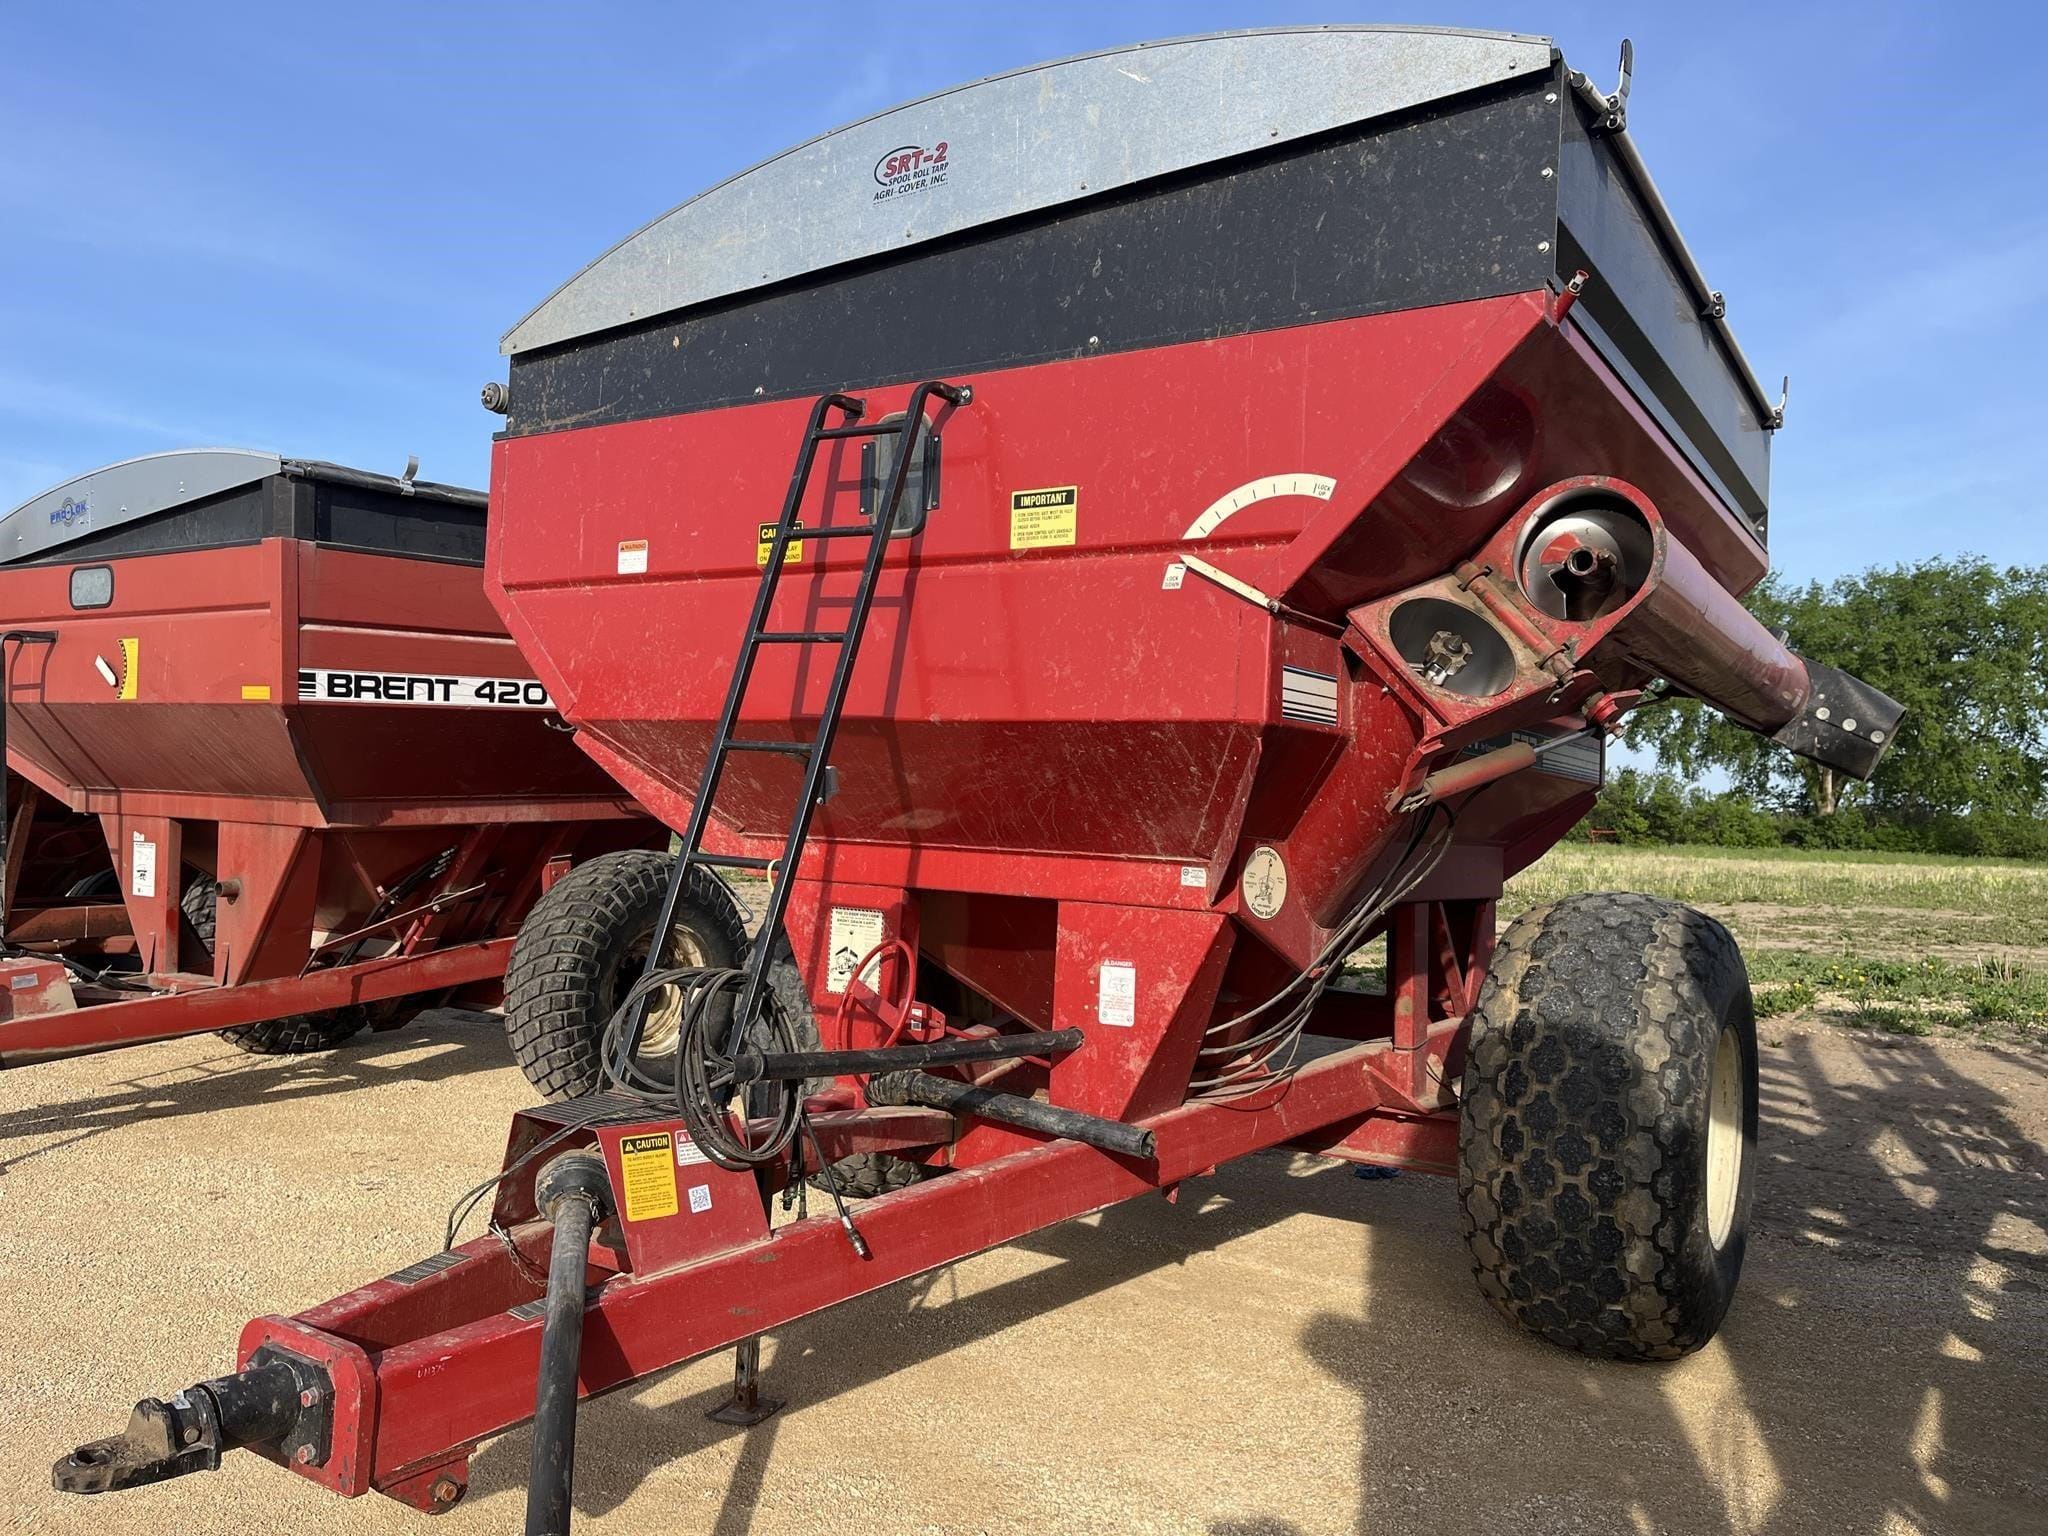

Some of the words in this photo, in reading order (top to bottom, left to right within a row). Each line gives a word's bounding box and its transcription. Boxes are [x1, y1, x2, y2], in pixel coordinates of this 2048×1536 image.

[883, 142, 948, 178] SRT-2
[888, 173, 912, 187] SPOOL
[912, 169, 929, 179] ROLL
[931, 162, 949, 174] TARP
[930, 173, 948, 186] INC.
[1317, 483, 1331, 491] LOCK
[1021, 492, 1067, 507] IMPORTANT
[327, 673, 459, 702] BRENT
[474, 681, 547, 705] 420
[636, 1137, 668, 1149] CAUTION
